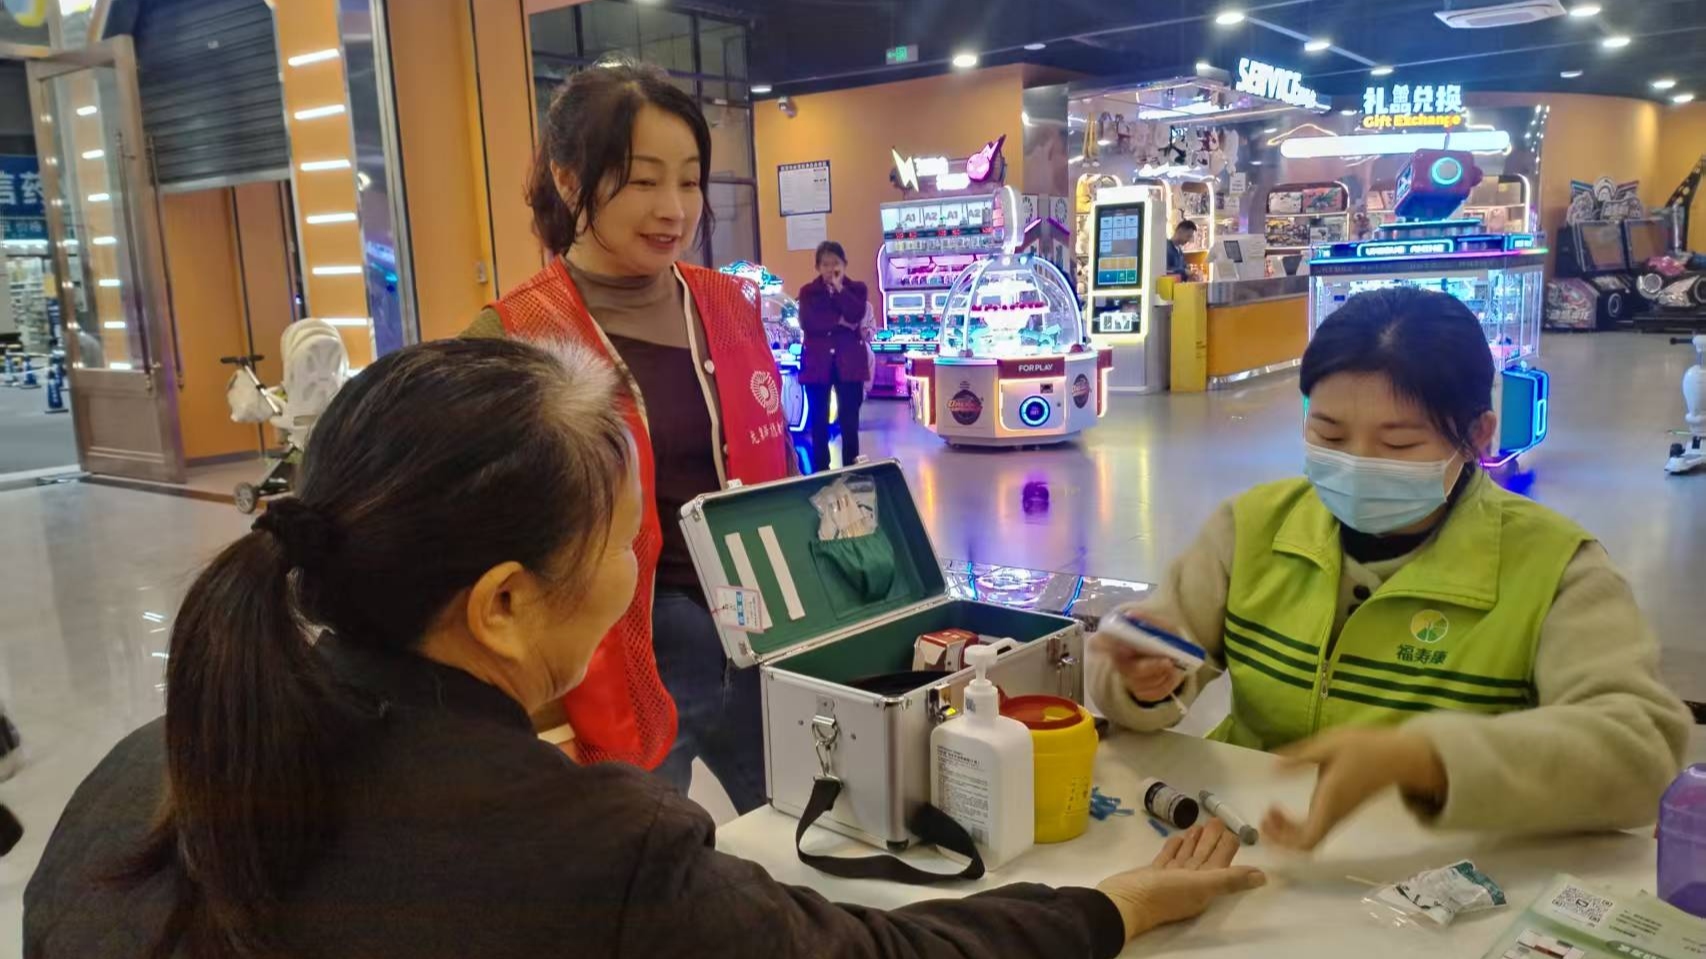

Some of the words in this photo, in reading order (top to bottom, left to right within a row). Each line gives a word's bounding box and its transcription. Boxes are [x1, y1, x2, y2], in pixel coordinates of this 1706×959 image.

[1363, 114, 1392, 128] Gift
[1393, 113, 1461, 127] Exchange
[905, 213, 916, 222] A1
[925, 212, 938, 220] A2
[947, 210, 958, 220] A1
[968, 208, 981, 218] A2
[1018, 364, 1035, 373] FOR
[1035, 363, 1053, 372] PLAY
[1396, 643, 1449, 664] 福寿康
